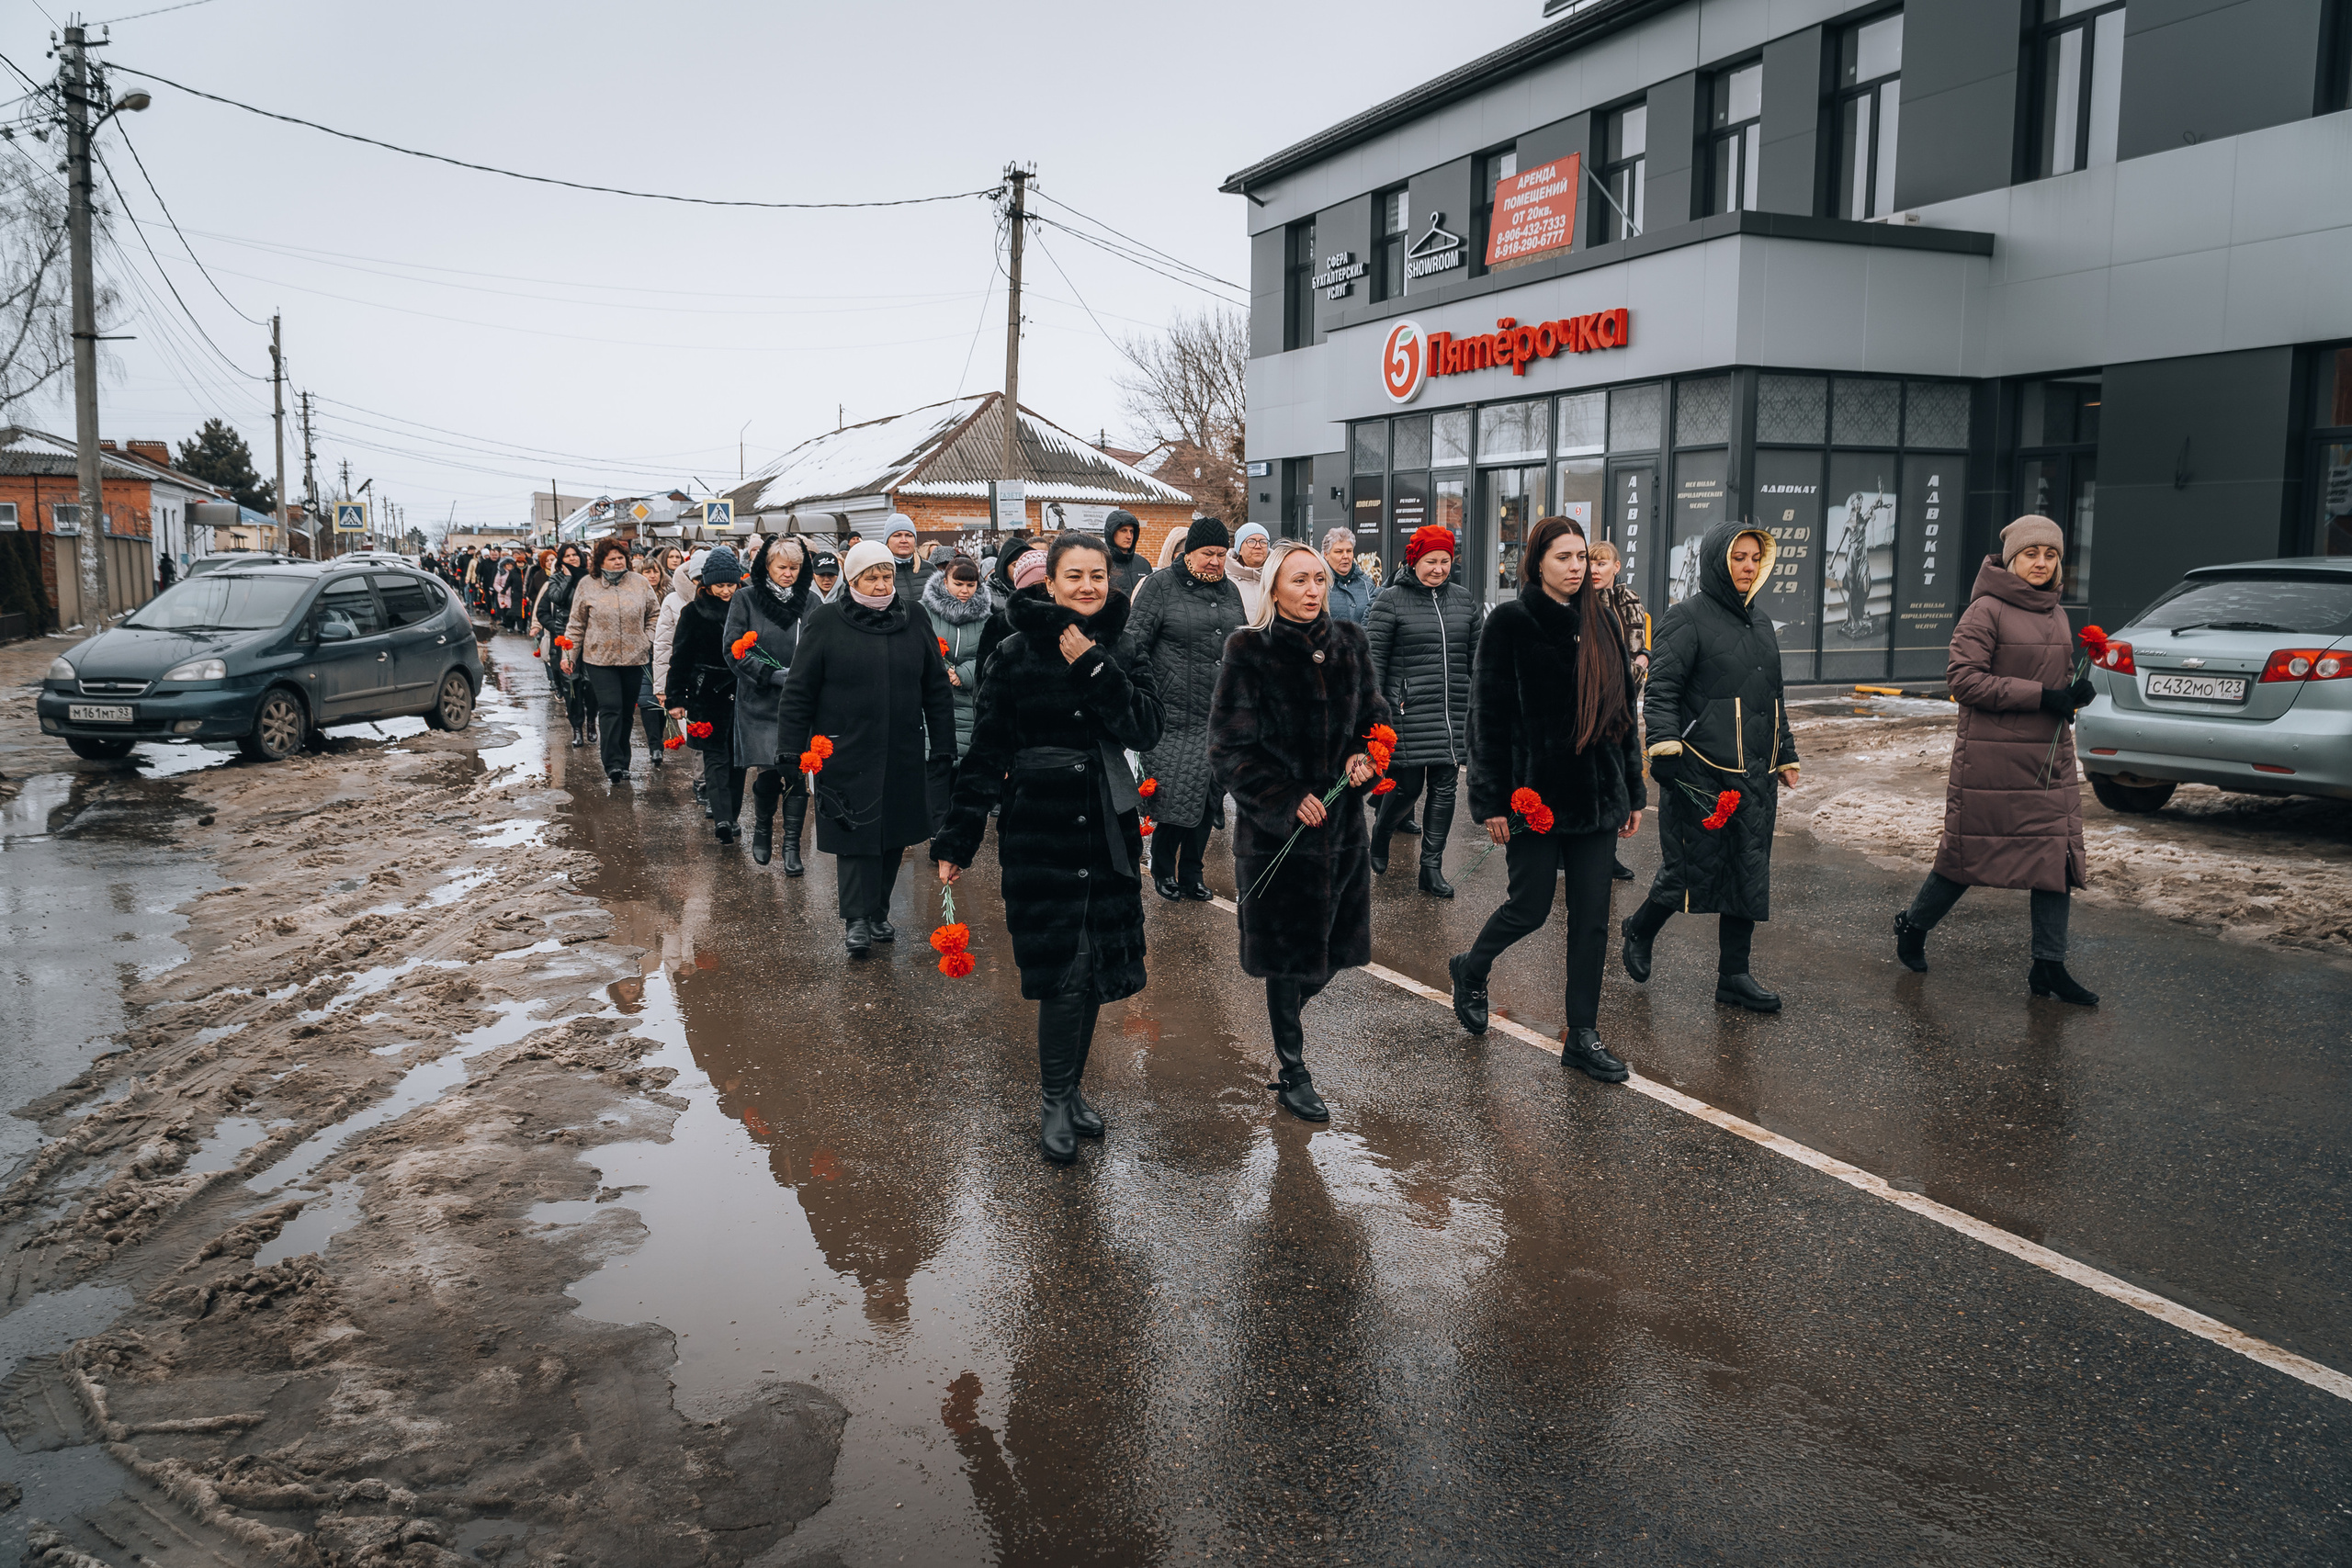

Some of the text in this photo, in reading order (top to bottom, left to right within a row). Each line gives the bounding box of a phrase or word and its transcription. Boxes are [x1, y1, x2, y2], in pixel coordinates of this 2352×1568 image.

[1517, 165, 1556, 190] АРЕНДА
[1503, 176, 1568, 211] ПОМЕЩЕНИЙ
[1512, 206, 1553, 225] ОТ 20кв.
[1497, 214, 1566, 245] 8-906-432-7333
[1494, 229, 1566, 258] 8-918-290-6777
[1327, 252, 1349, 270] СФЕРА
[1408, 250, 1459, 279] SHOWROOM
[1312, 262, 1364, 289] БУХГАЛТЕРСКИХ
[1327, 283, 1348, 300] УСЛУГ
[1427, 309, 1629, 377] Пятёрочка
[1760, 484, 1816, 494] АДВОКАТ
[1782, 509, 1794, 521] 8
[1625, 475, 1639, 585] АДВОКАТ
[1923, 475, 1939, 585] АДВОКАТ
[1773, 563, 1798, 576] 30
[1772, 581, 1798, 592] 29
[2218, 681, 2241, 693] 123
